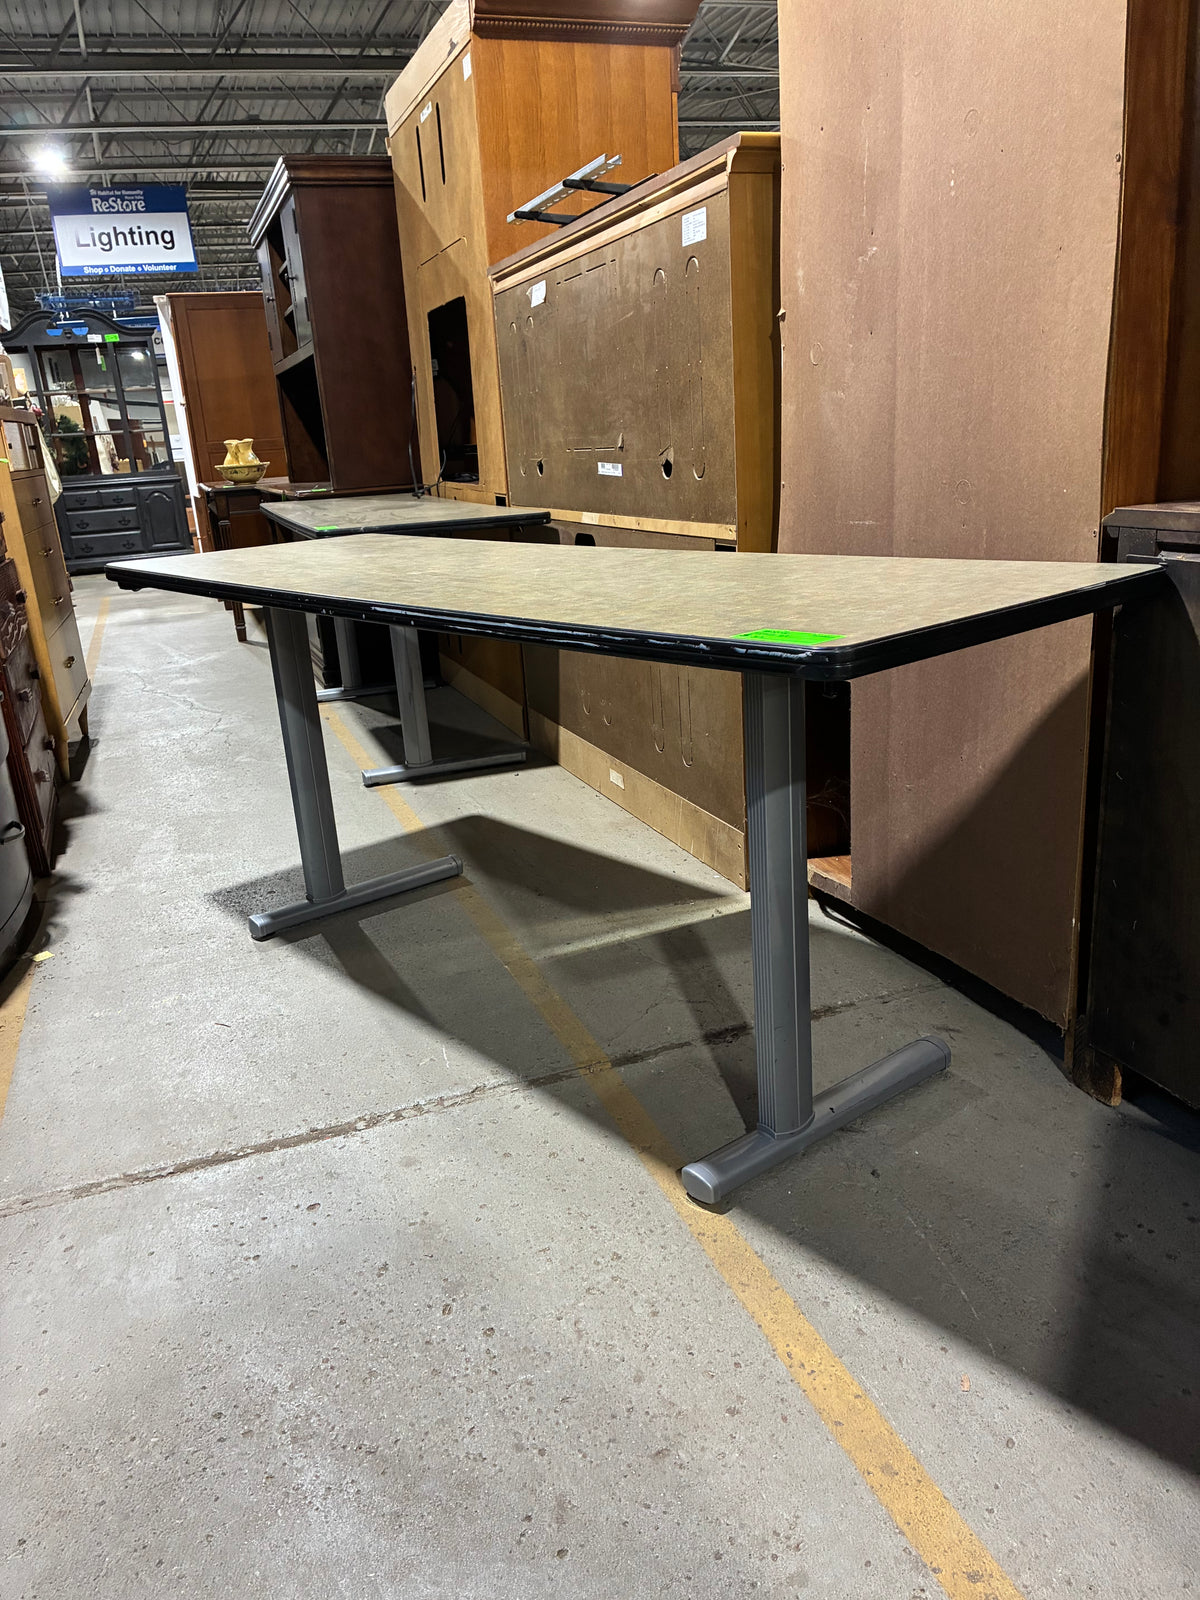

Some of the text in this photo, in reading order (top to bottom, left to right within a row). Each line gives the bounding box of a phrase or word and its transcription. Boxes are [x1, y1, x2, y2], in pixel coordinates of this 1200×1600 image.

[91, 197, 146, 212] ReStore
[75, 225, 175, 252] Lighting
[83, 264, 177, 275] Shop Donate Volunteer
